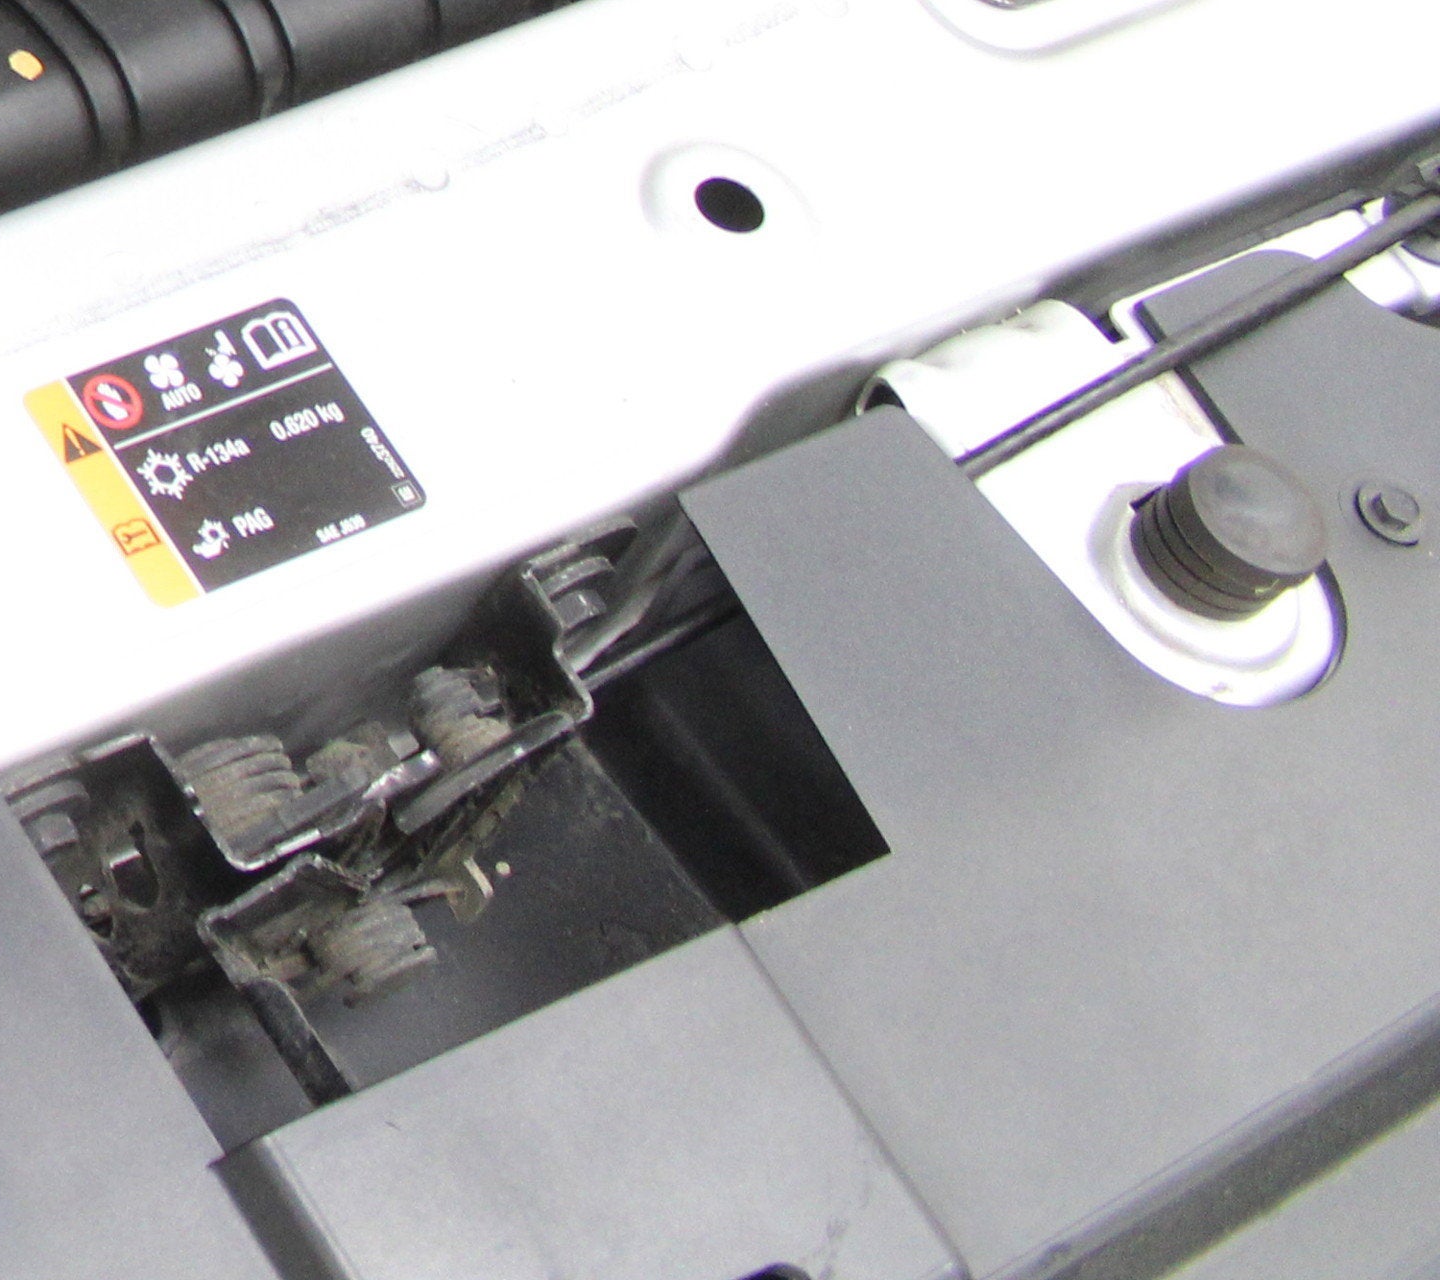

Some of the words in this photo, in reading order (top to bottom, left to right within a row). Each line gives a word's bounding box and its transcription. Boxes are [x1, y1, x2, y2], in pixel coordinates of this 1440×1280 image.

[161, 383, 203, 411] AUTO
[269, 407, 320, 442] 0.620
[316, 401, 345, 423] kg
[186, 438, 251, 473] R-134a
[232, 506, 275, 538] PAG
